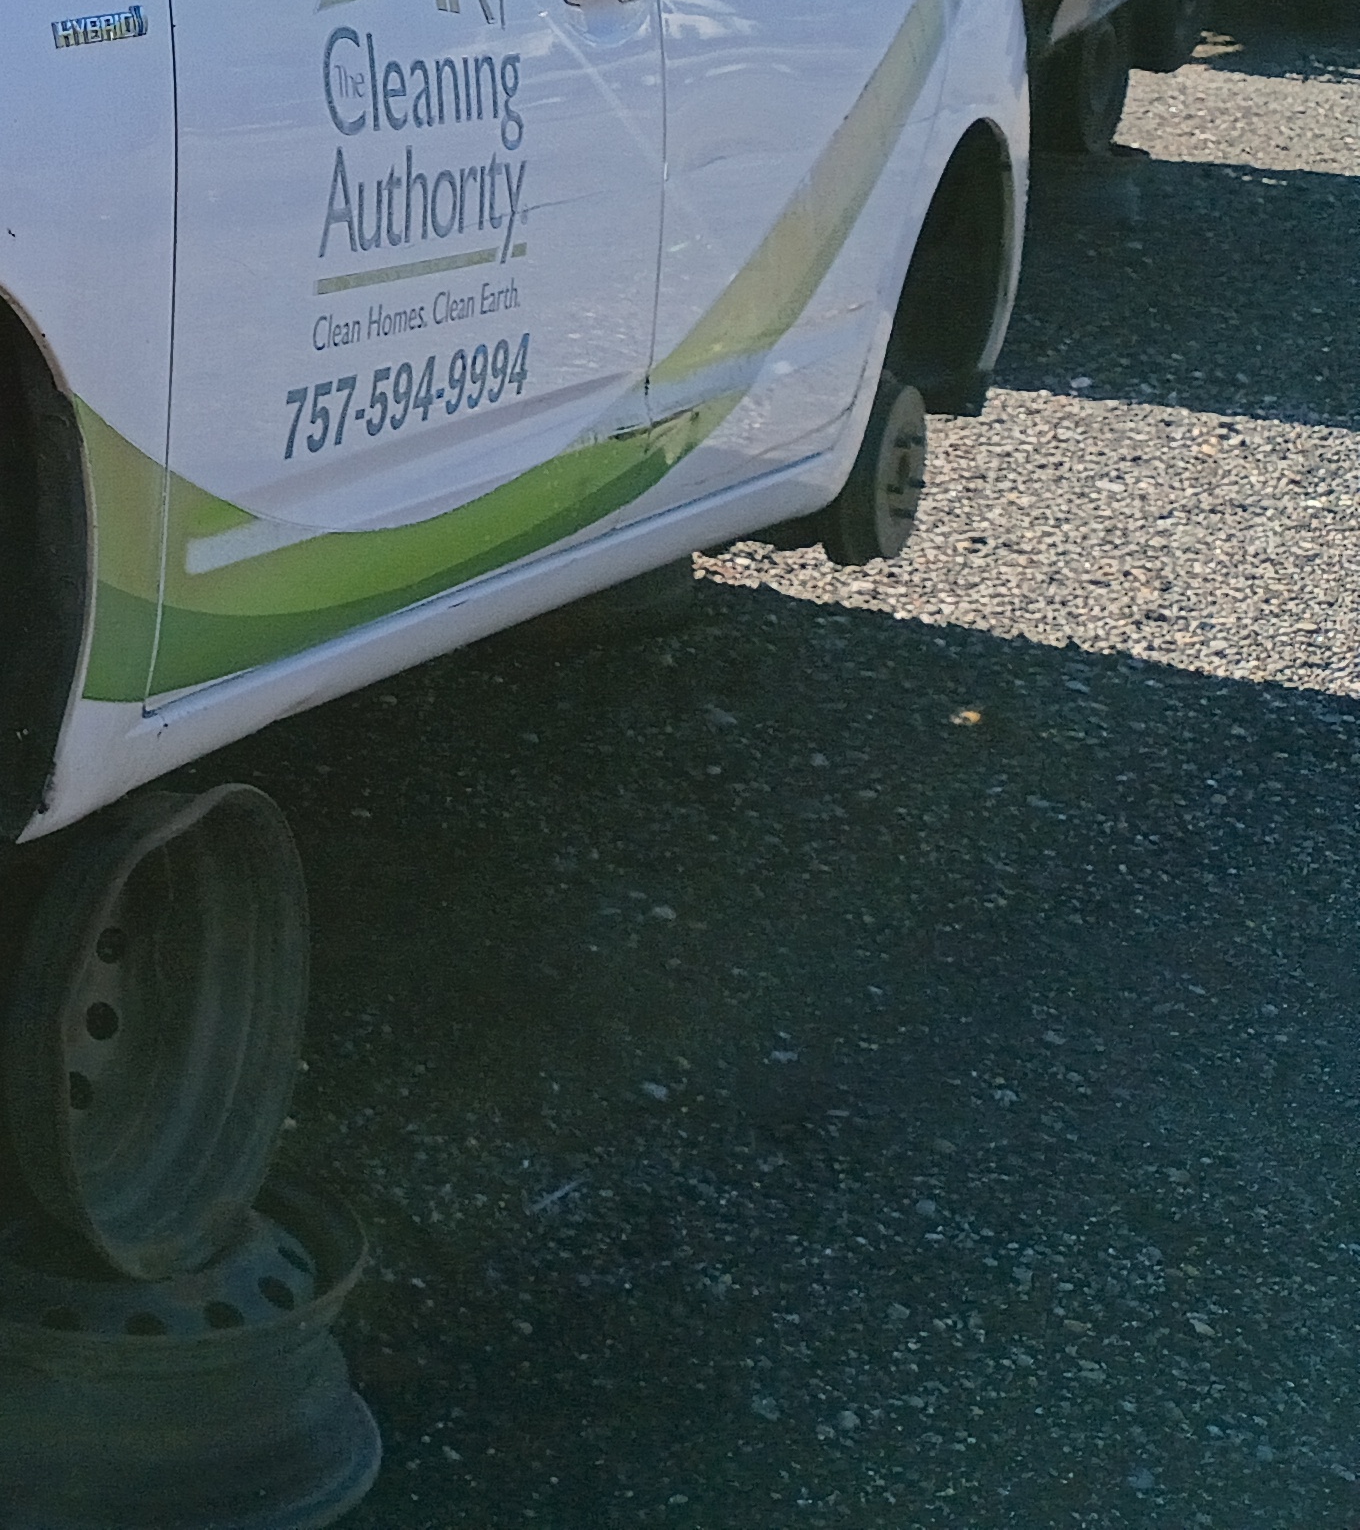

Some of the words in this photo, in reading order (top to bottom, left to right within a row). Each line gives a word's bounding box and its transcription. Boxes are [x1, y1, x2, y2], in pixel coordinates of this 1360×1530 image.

[51, 10, 138, 49] HYBRID
[323, 26, 524, 151] Cleaning
[333, 64, 365, 98] The
[312, 314, 361, 351] Clean
[367, 304, 428, 339] Homes.
[432, 290, 475, 325] Clean
[480, 277, 520, 315] Earth.
[284, 332, 530, 460] 757-594-9994
